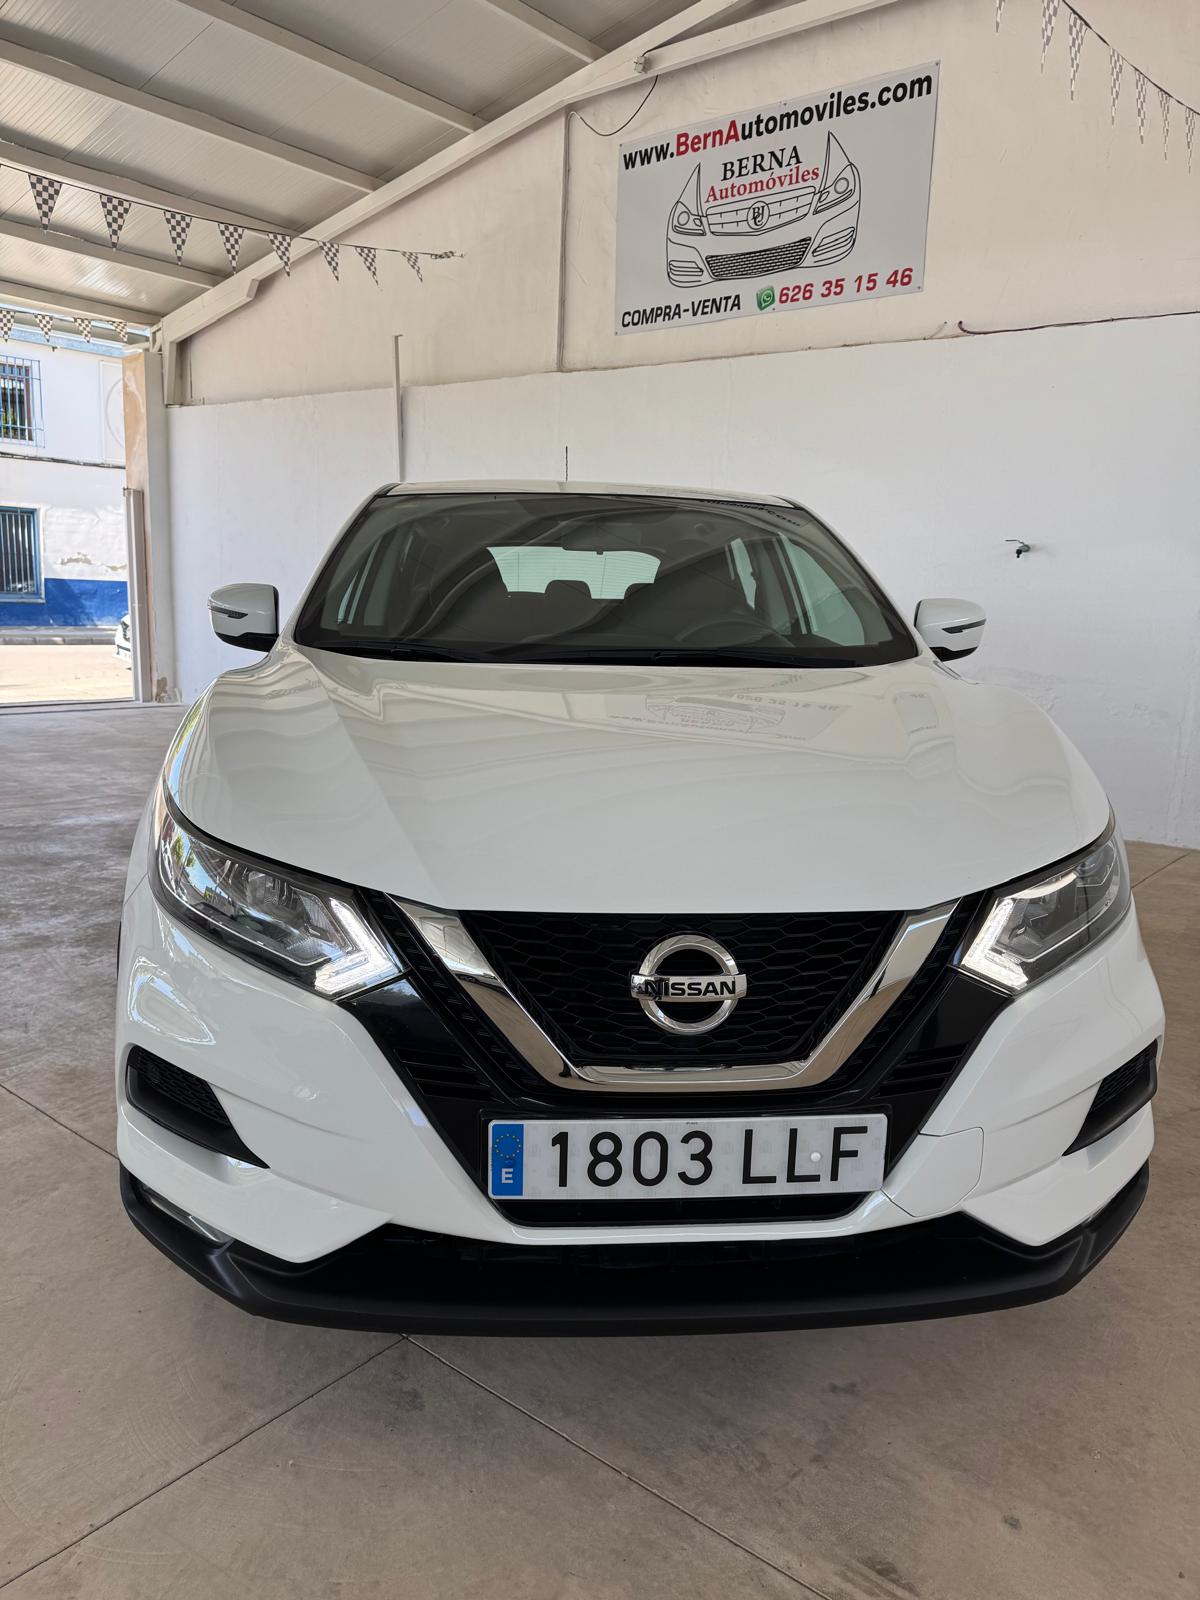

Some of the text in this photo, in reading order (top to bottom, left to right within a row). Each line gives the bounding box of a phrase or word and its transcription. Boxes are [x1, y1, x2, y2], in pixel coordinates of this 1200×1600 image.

[623, 74, 933, 170] www.BernAutomoviles.com
[720, 145, 802, 182] BERNA
[704, 166, 820, 204] Automóviles
[779, 268, 913, 304] 626 35 15 46
[621, 294, 741, 328] COMPRA-VENTA
[644, 979, 736, 997] NISSAN
[551, 1126, 868, 1188] 1803 LLF
[501, 1167, 514, 1184] E
